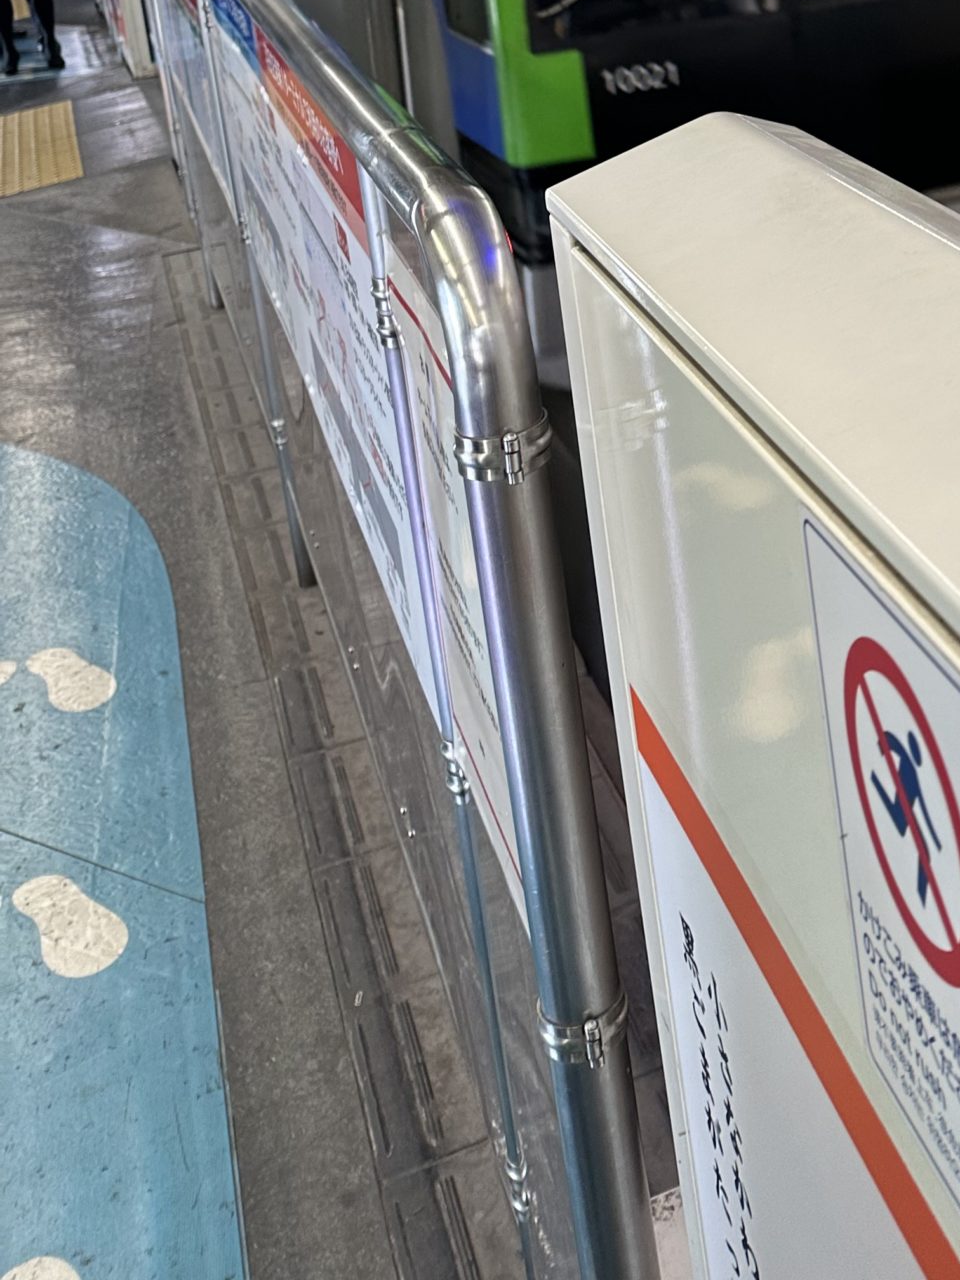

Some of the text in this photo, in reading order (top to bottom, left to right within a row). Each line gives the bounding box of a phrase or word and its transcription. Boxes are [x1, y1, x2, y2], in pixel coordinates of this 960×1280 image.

[601, 61, 680, 96] 10021
[868, 968, 947, 1111] Do not rush
